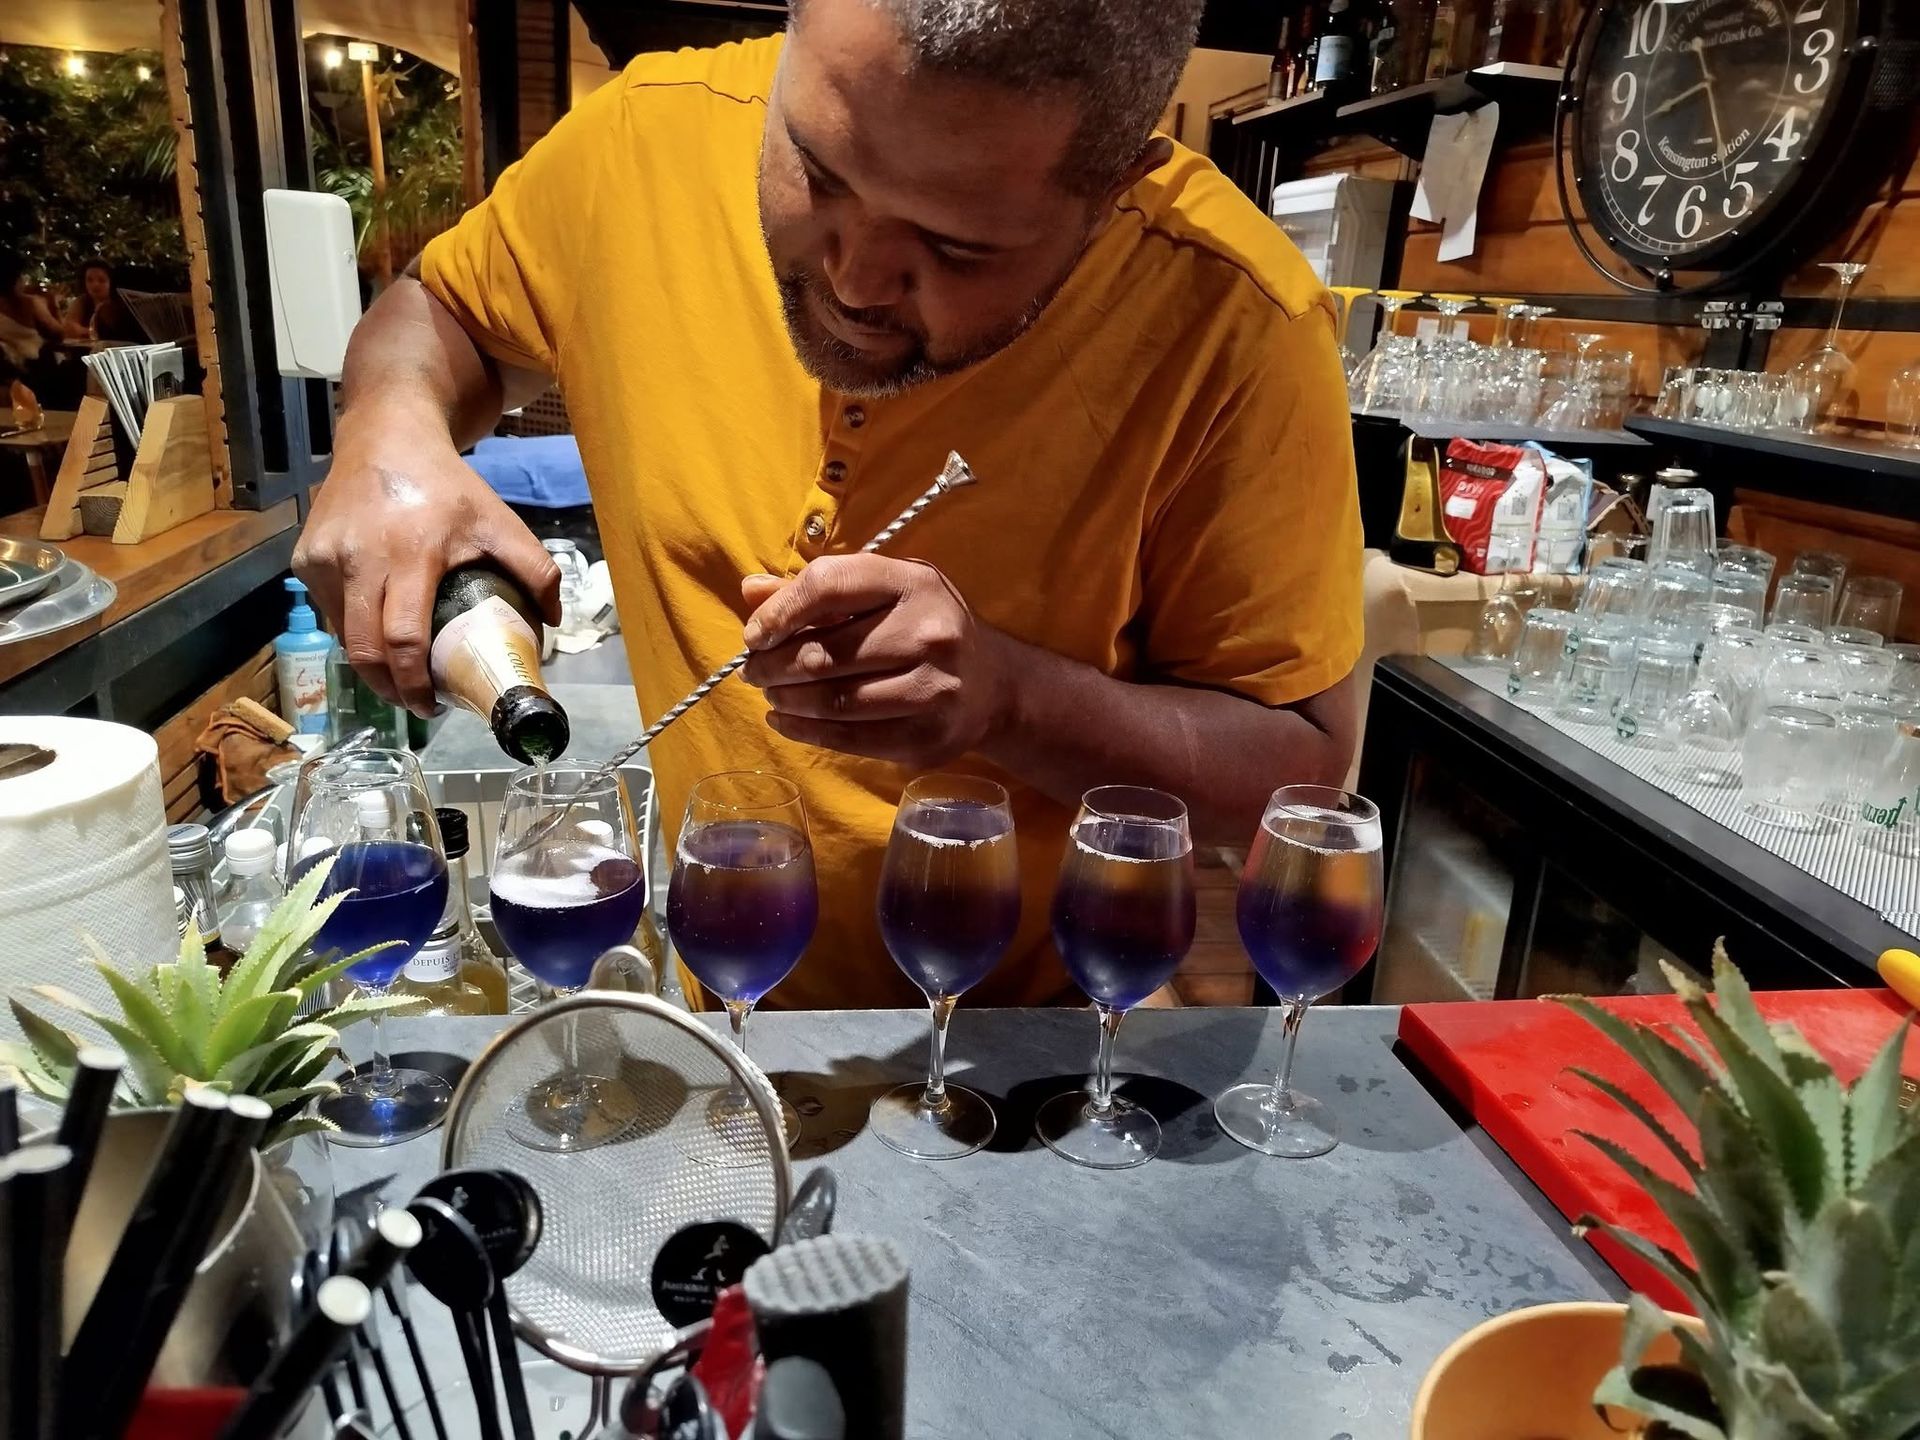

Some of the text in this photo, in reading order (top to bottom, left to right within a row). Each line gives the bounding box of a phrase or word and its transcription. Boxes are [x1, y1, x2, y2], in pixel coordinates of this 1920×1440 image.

[1623, 0, 1668, 59] 10
[1794, 28, 1835, 94] 3
[1610, 71, 1638, 123] 9
[1611, 129, 1640, 183] 8
[1658, 128, 1750, 172] Kensington stion
[1763, 106, 1801, 162] 4
[1637, 174, 1667, 227] 7
[1674, 185, 1707, 239] 6
[1722, 162, 1760, 219] 5
[413, 956, 450, 967] DEPUIS
